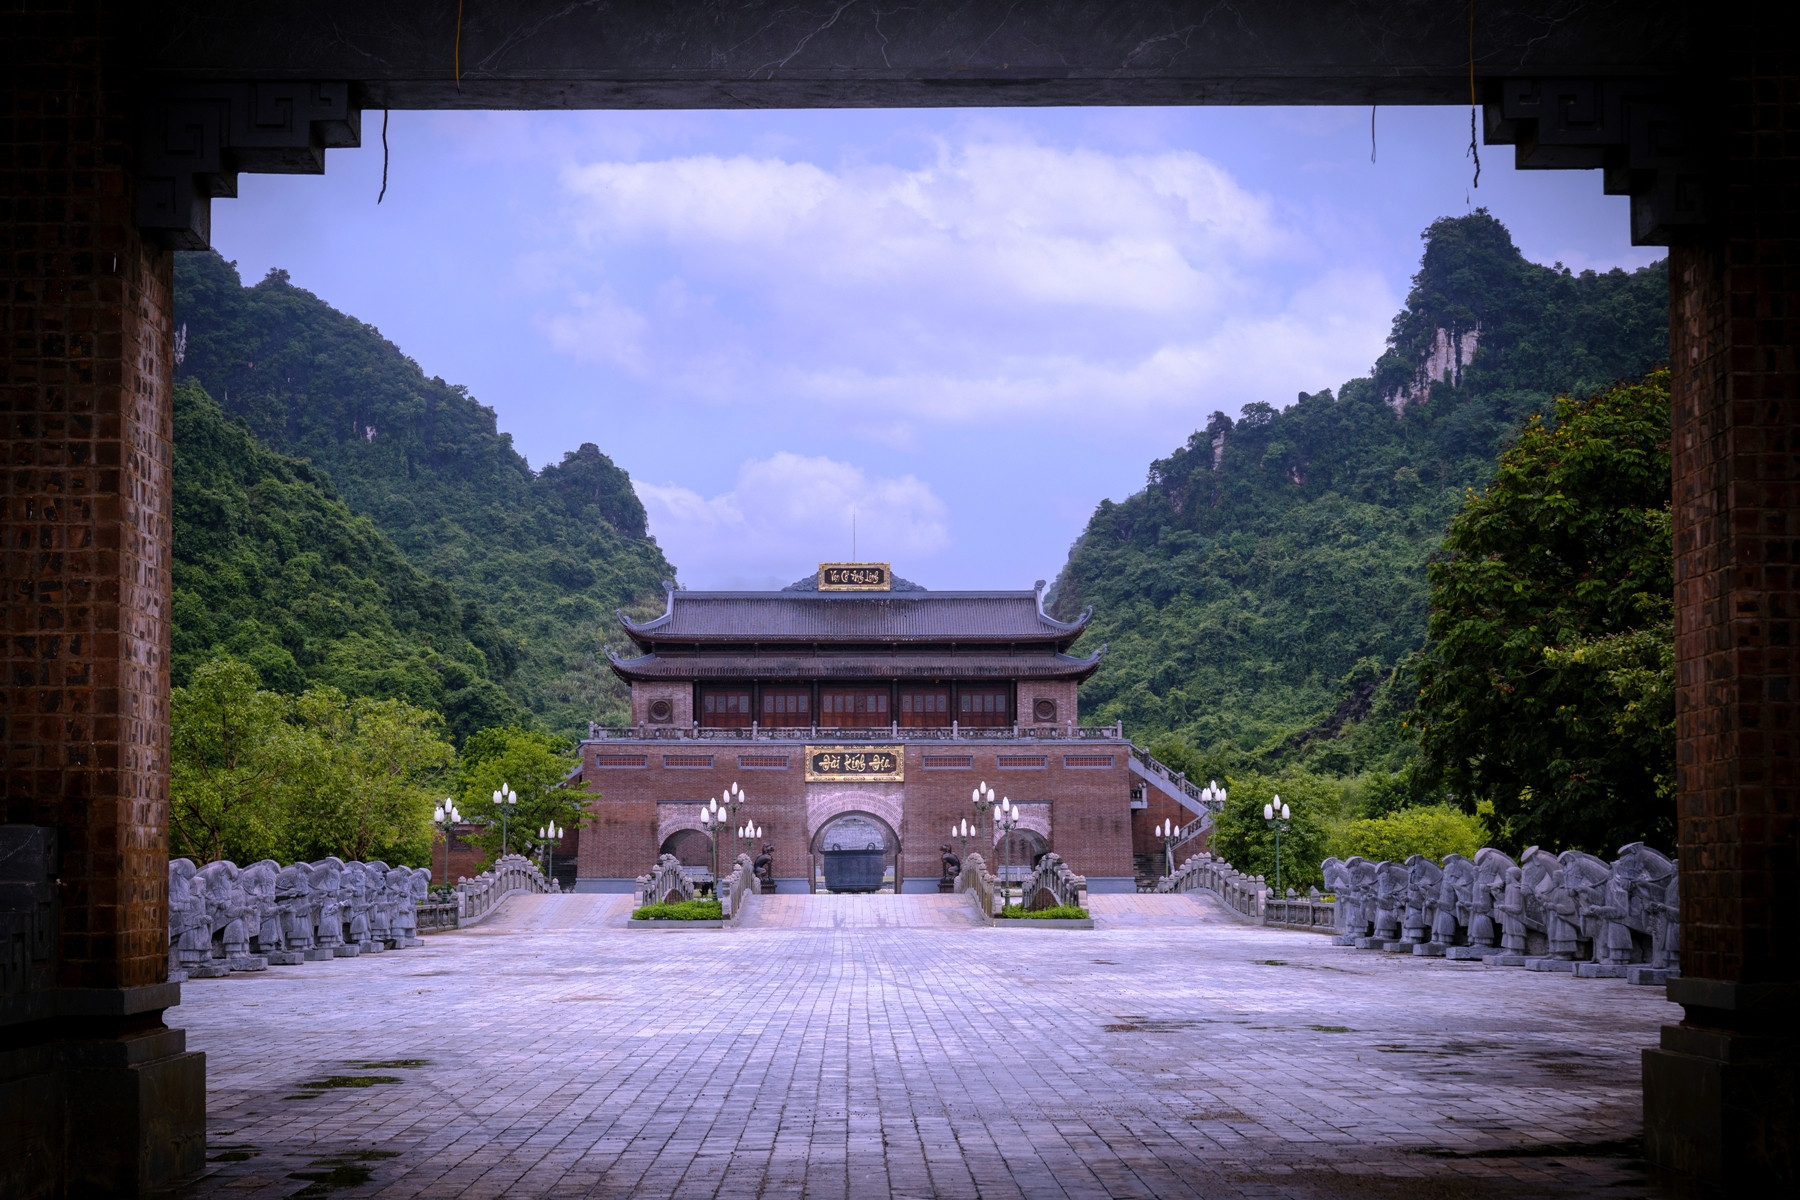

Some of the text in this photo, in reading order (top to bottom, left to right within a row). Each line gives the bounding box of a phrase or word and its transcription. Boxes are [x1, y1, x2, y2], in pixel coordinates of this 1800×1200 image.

[818, 753, 891, 772] Đài Kính Địa
